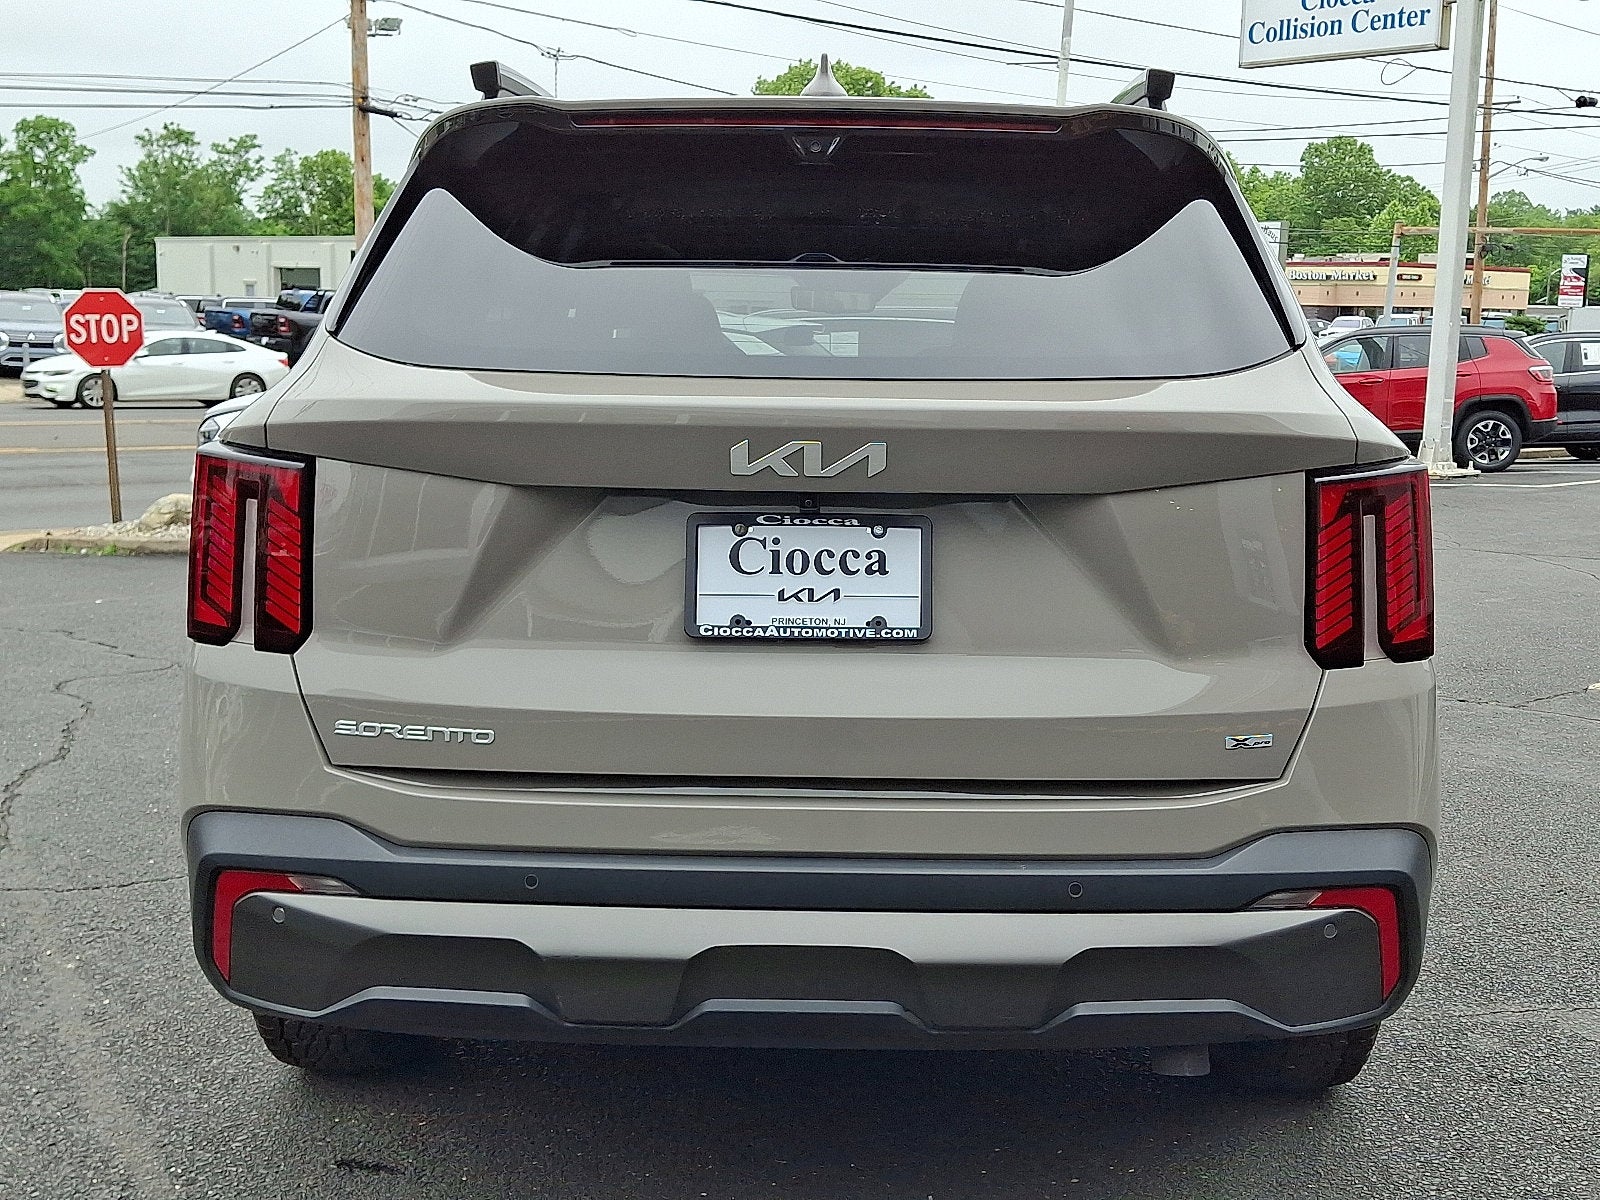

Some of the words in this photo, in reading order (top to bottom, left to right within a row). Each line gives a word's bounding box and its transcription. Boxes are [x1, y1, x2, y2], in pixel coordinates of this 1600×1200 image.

[1248, 15, 1343, 45] Collision
[1351, 6, 1431, 34] Center
[1289, 269, 1327, 281] Boston
[1330, 269, 1376, 281] Market
[69, 313, 139, 345] STOP
[730, 438, 887, 478] KIA
[756, 514, 861, 526] Ciocca
[728, 536, 889, 576] Ciocca
[777, 587, 841, 604] KIA
[771, 617, 832, 627] PRINCETON,
[833, 617, 847, 627] NJ
[334, 719, 495, 744] SORENTO
